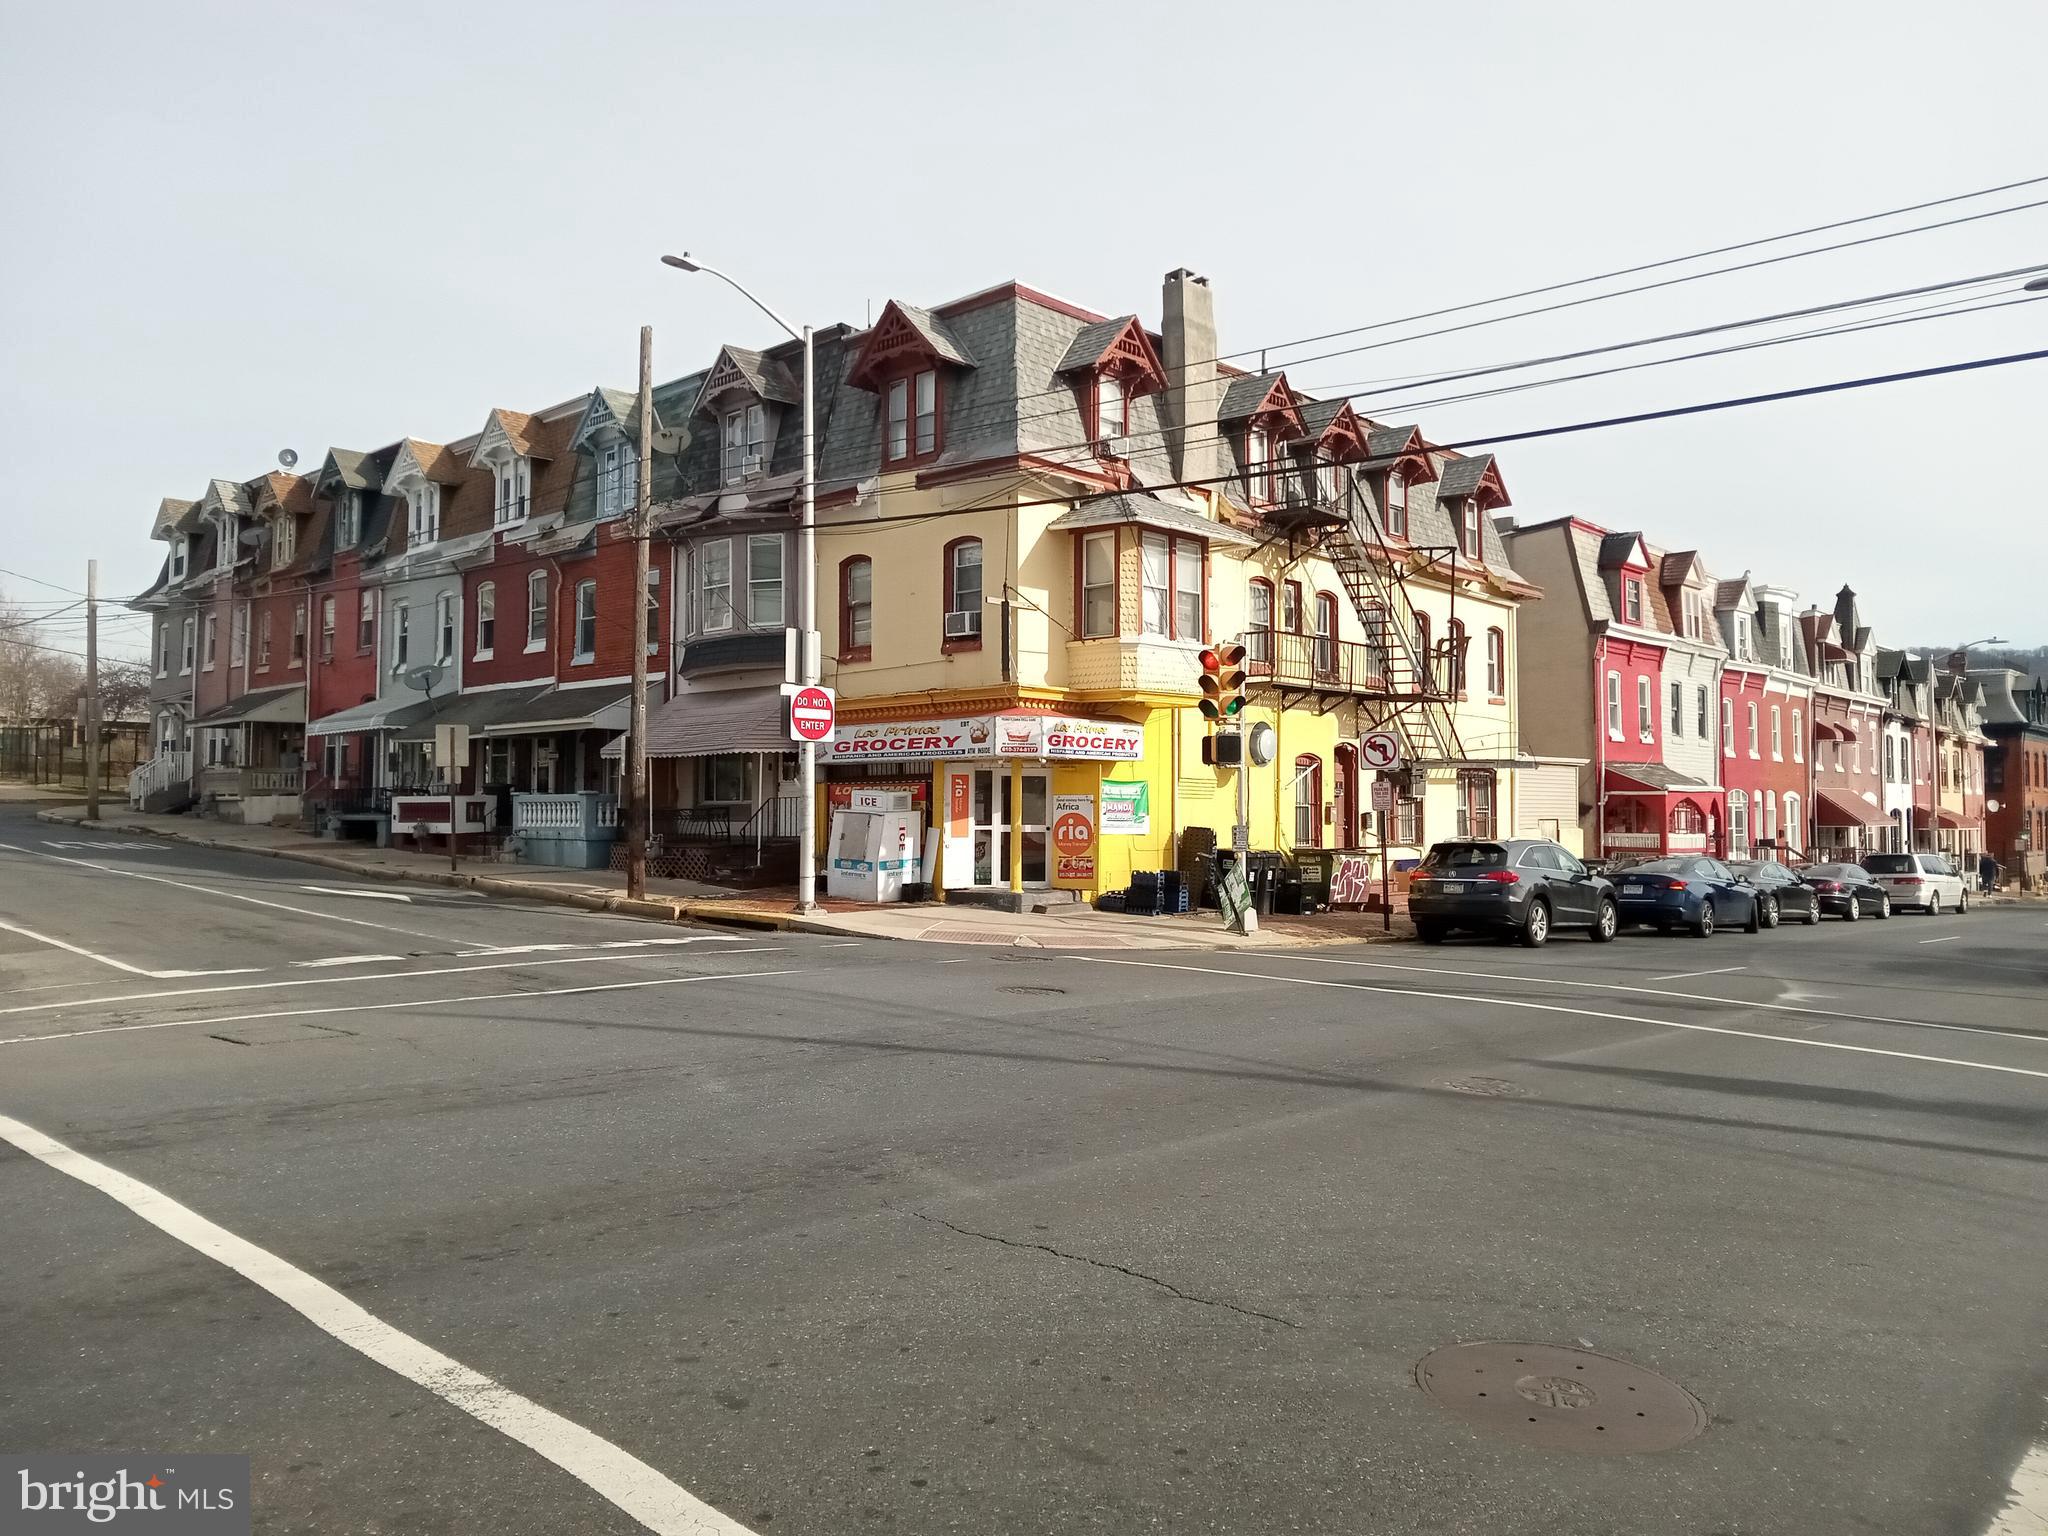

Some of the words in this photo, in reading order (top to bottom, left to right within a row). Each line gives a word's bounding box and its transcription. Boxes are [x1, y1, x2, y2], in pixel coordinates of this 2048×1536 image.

[797, 697, 808, 706] DO
[812, 698, 828, 707] NOT
[800, 720, 825, 731] ENTER
[834, 735, 962, 753] GROCERY
[1047, 734, 1138, 751] GROCERY
[883, 750, 921, 758] AMERICAN
[834, 786, 861, 795] LO
[955, 778, 967, 798] ria
[860, 797, 878, 807] ICE
[1056, 803, 1080, 811] Africa
[1058, 817, 1089, 840] ria
